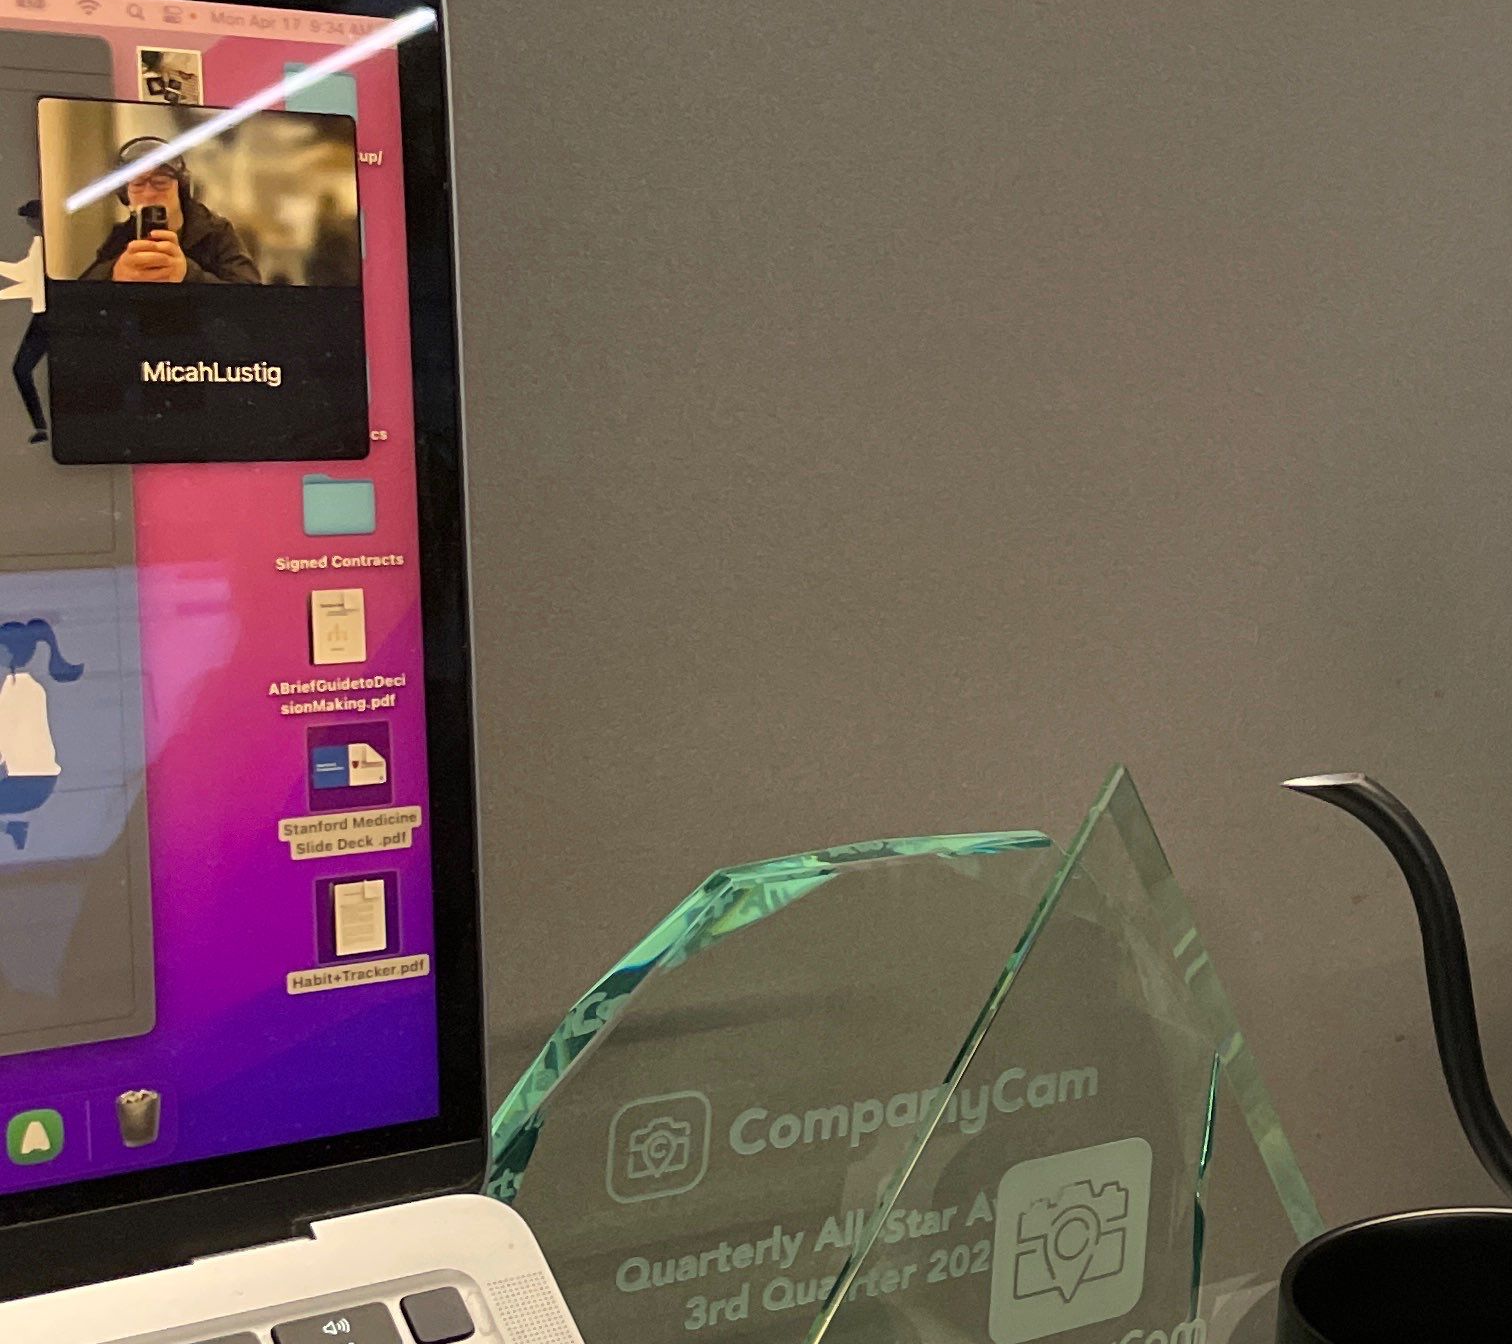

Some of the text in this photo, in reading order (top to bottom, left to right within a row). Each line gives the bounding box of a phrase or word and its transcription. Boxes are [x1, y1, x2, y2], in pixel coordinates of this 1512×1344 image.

[141, 360, 282, 387] MicahLustig
[275, 554, 404, 573] Signed Contracts
[268, 672, 406, 697] ABriefGuidetoDeci
[280, 693, 397, 716] sionMaking.pdf
[283, 811, 418, 837] Stanford Medicine
[296, 839, 333, 855] Slide
[337, 835, 374, 851] Deck
[729, 1065, 1099, 1156] CompanyCam
[615, 1224, 805, 1293] Quarterly
[813, 1208, 866, 1253] All
[880, 1205, 958, 1245] Star
[683, 1239, 993, 1331] 3rd Quarter 202
